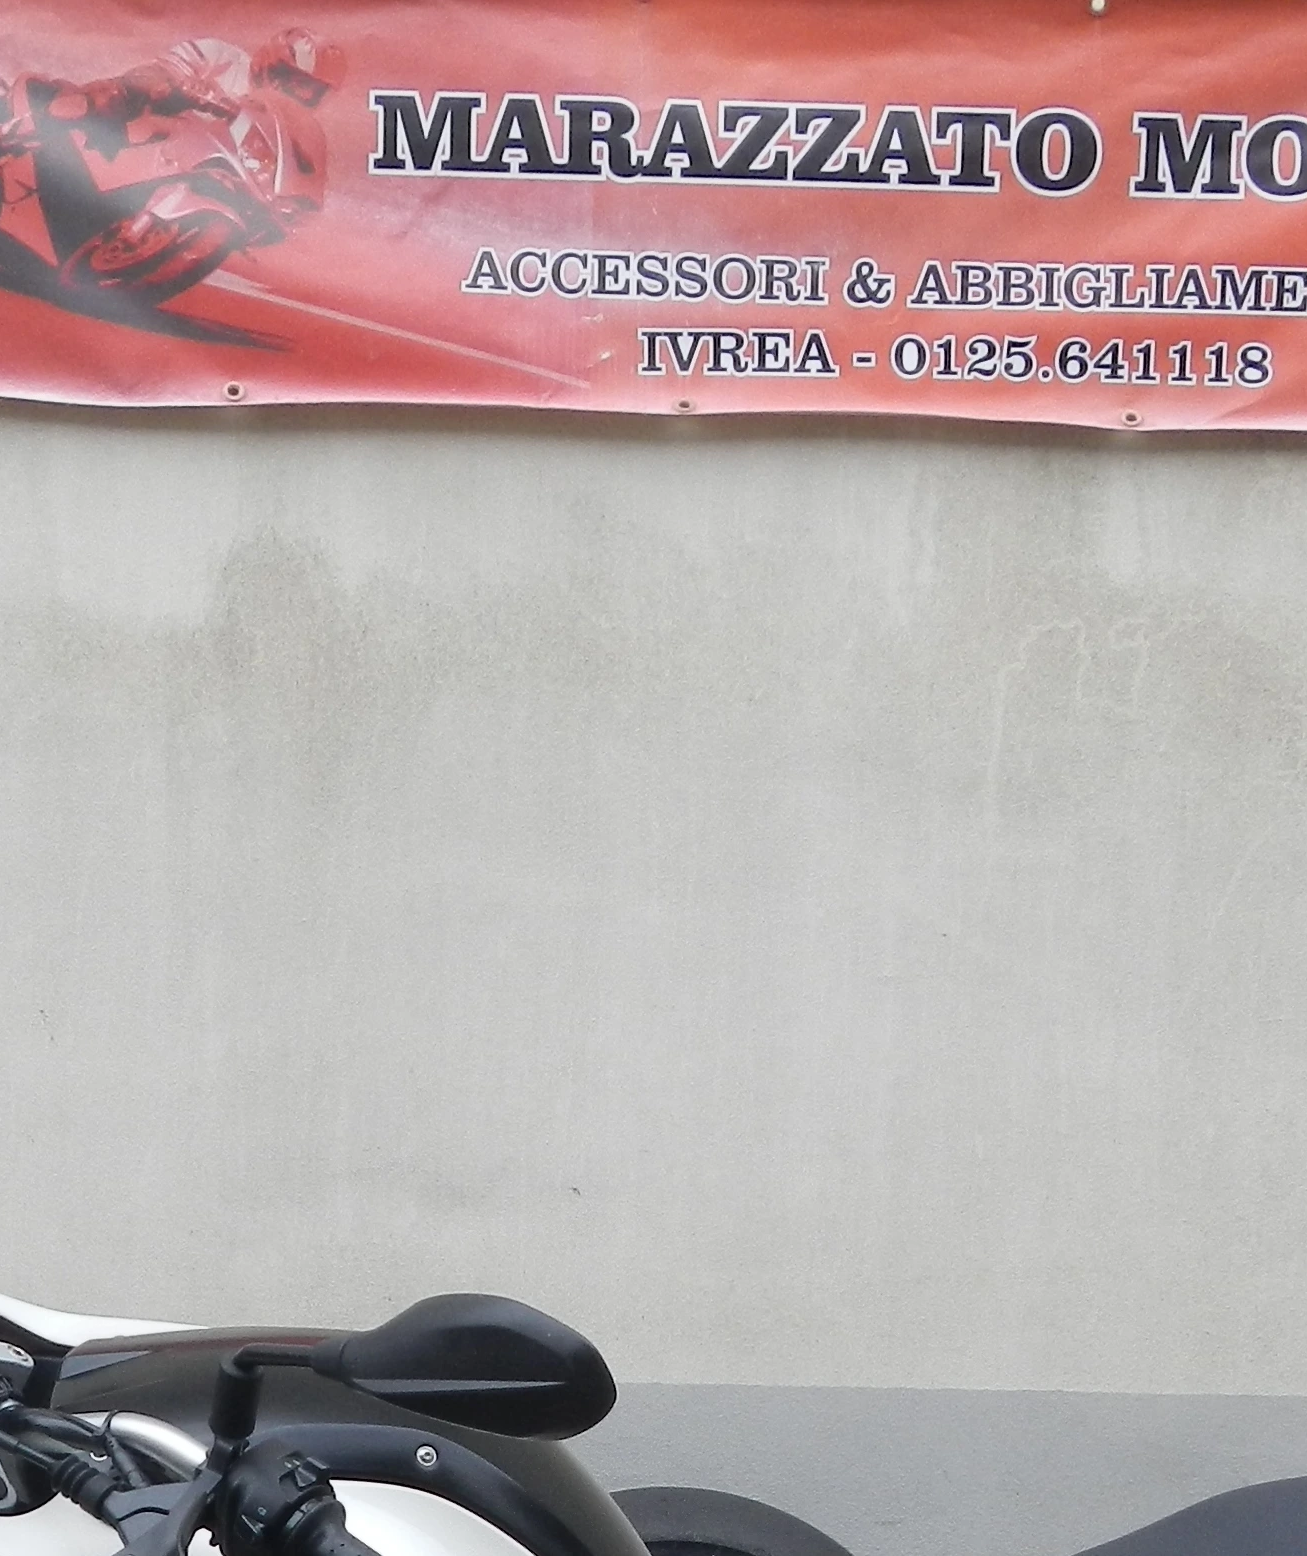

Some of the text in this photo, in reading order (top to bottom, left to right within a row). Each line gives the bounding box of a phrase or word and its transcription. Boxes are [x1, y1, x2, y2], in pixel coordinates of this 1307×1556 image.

[369, 90, 1102, 198] MARAZZATO
[460, 247, 830, 305] ACCESSORI
[842, 258, 895, 308] &
[638, 328, 839, 377] IVREA
[890, 334, 1272, 387] 0125.641118
